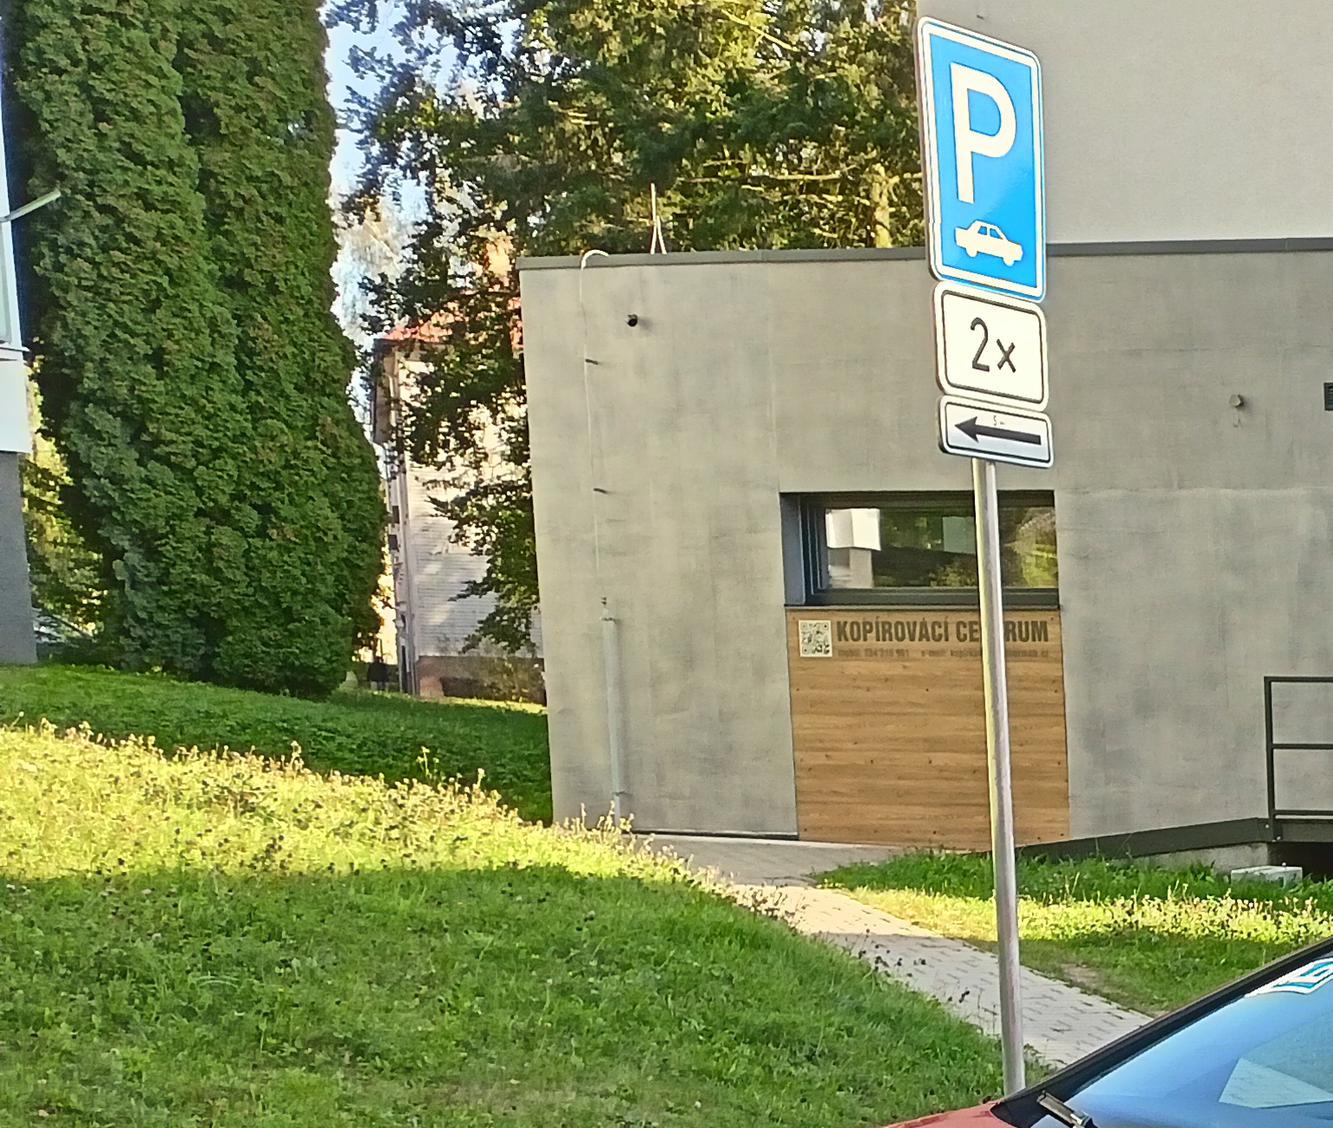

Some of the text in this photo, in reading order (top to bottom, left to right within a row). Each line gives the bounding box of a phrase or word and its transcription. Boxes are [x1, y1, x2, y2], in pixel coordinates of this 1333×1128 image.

[950, 62, 1017, 204] P
[970, 317, 1016, 373] 2x
[836, 615, 1049, 642] KOPÍROVÁCÍ CERUM
